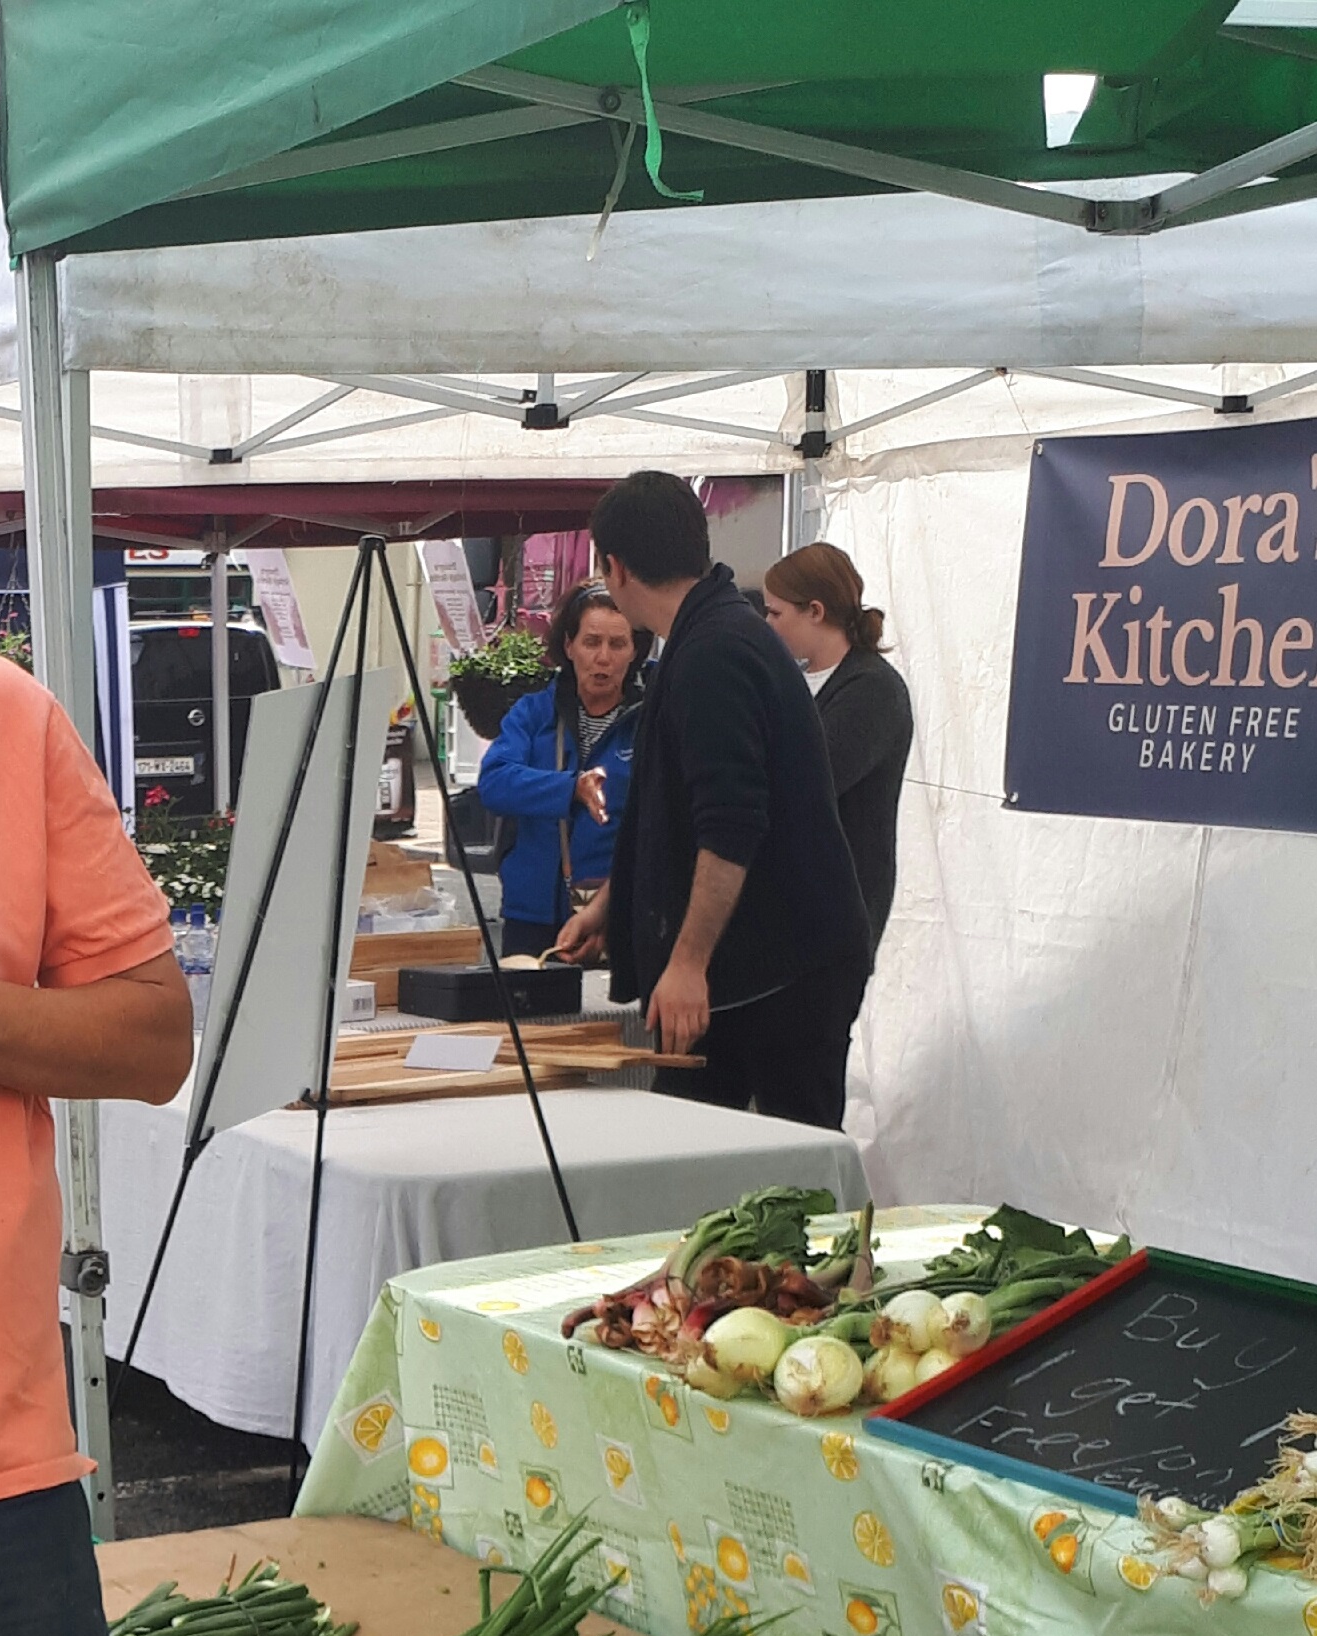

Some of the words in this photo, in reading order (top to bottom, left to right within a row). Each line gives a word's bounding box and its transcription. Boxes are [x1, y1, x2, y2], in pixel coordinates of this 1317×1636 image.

[1098, 453, 1317, 567] Dora'
[1062, 583, 1317, 688] Kitche
[1109, 703, 1217, 736] GLUTEN
[1228, 706, 1301, 739] FREE
[1139, 739, 1256, 774] BAKERY
[1122, 1292, 1297, 1390] Buy
[1044, 1377, 1200, 1418] get
